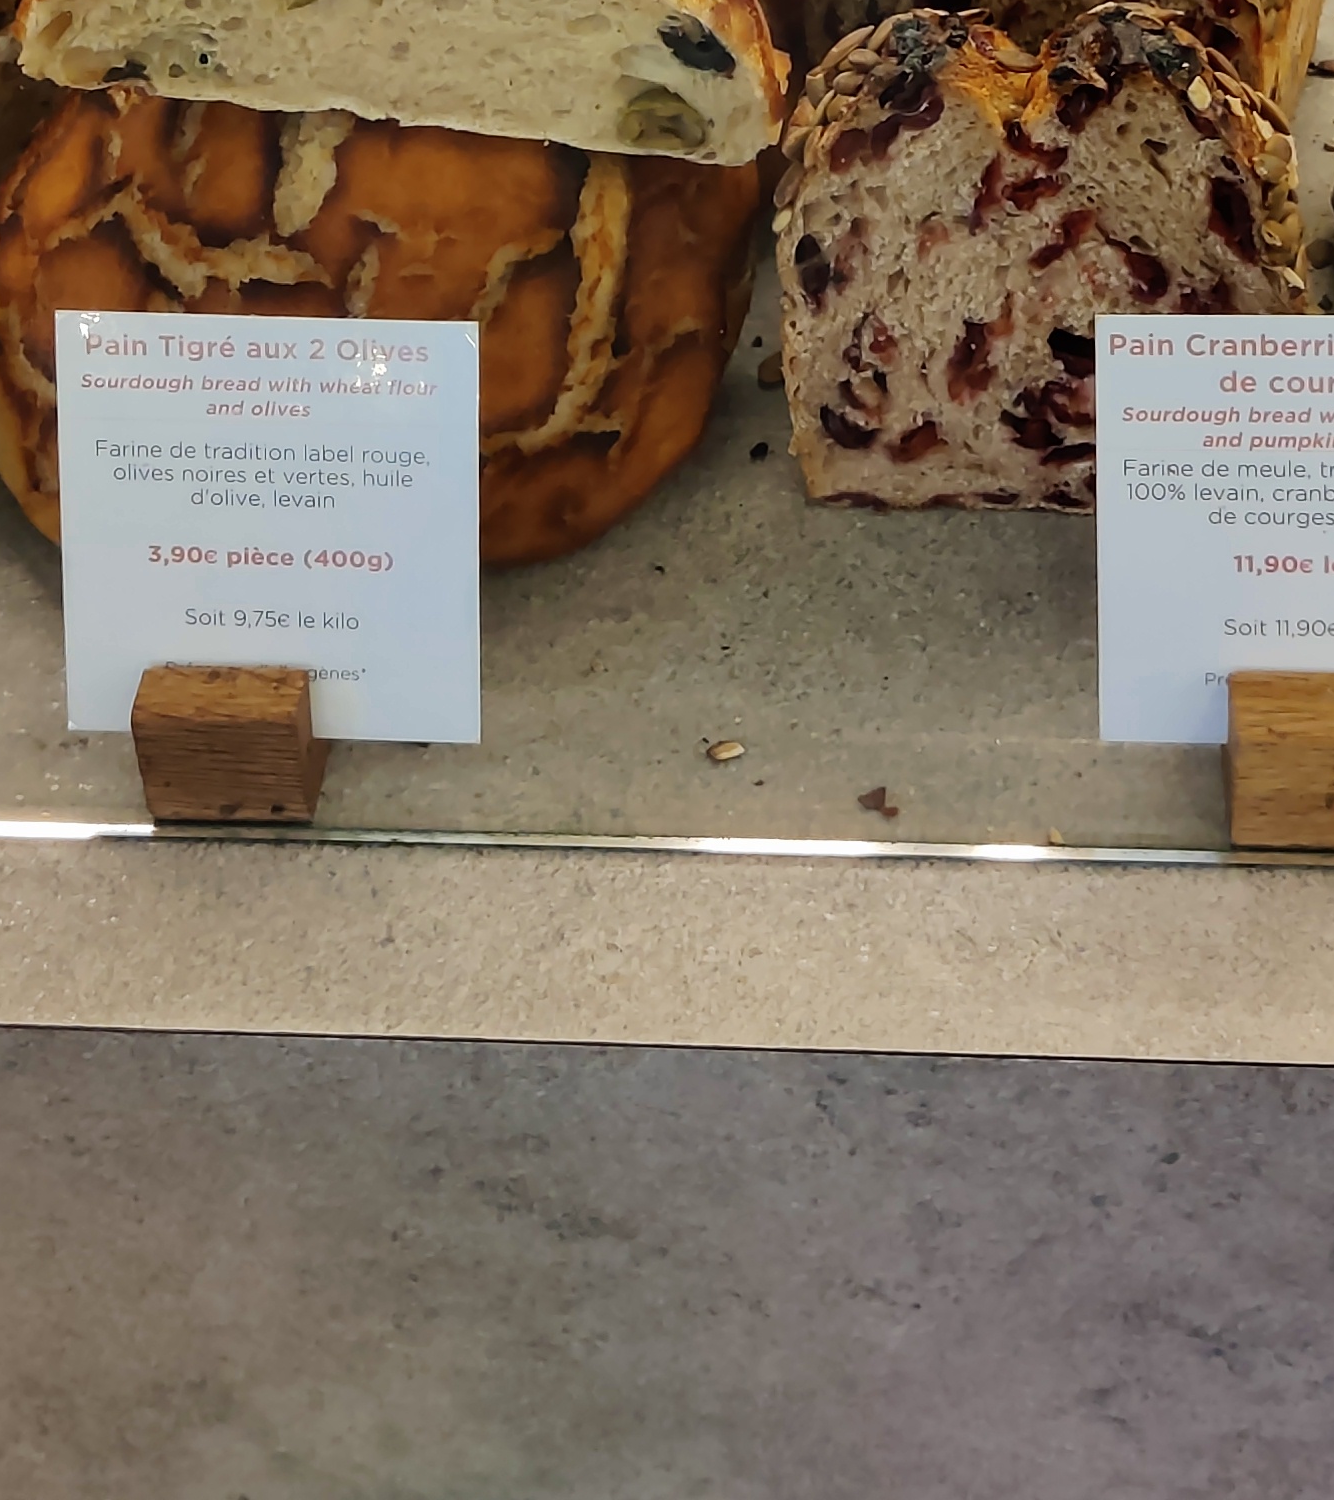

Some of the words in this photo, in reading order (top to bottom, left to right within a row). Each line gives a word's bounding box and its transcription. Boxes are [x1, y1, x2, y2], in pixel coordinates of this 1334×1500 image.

[83, 333, 148, 357] Pain
[157, 333, 237, 362] Tigré
[245, 340, 299, 361] aux
[307, 337, 328, 361] 2
[335, 337, 429, 363] Olives
[1109, 332, 1174, 356] Pain
[80, 373, 194, 393] Sourdough
[201, 374, 262, 393] bread
[267, 376, 312, 394] with
[318, 377, 384, 395] wheat
[385, 378, 437, 397] flour
[1219, 369, 1258, 394] de
[205, 399, 245, 416] and
[250, 399, 311, 418] olives
[1121, 406, 1241, 426] Sourdough
[1247, 406, 1312, 424] bread
[1202, 431, 1244, 448] and
[95, 439, 163, 459] Farine
[169, 441, 197, 459] de
[204, 441, 296, 461] tradition
[304, 443, 354, 464] label
[362, 449, 430, 468] rouge,
[113, 462, 175, 482] olives
[182, 468, 247, 484] noires
[254, 467, 276, 485] et
[282, 468, 355, 487] vertes,
[363, 467, 413, 488] huile
[1123, 458, 1194, 478] Farine
[1201, 459, 1230, 478] de
[1237, 459, 1312, 480] meule,
[190, 487, 265, 509] d'olive,
[273, 488, 335, 509] levain
[1126, 482, 1186, 501] 100%
[1194, 482, 1264, 503] levain,
[1208, 507, 1237, 525] de
[148, 545, 218, 567] 3,90€
[226, 546, 295, 569] pièce
[303, 549, 394, 572] (400g)
[1233, 554, 1314, 577] 11,90€
[185, 608, 226, 627] Soit
[233, 609, 290, 629] 9,75€
[298, 610, 316, 629] le
[323, 611, 359, 630] kilo
[1224, 618, 1268, 637] Soit
